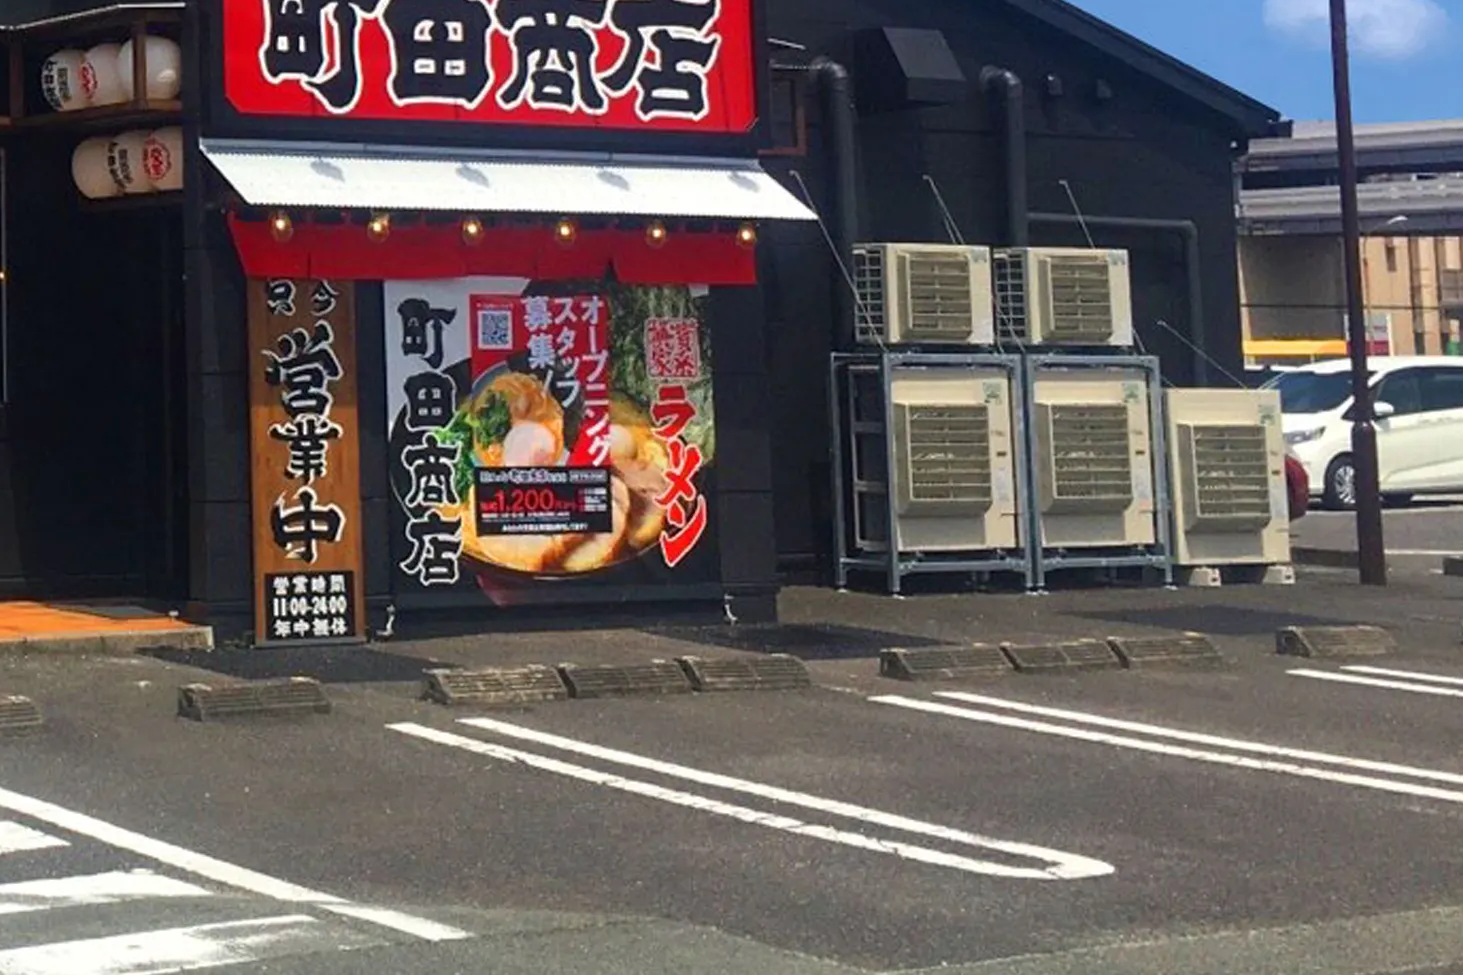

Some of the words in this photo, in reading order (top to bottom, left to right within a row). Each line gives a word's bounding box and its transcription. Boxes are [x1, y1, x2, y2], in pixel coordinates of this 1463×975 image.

[261, 320, 346, 565] 営業中
[396, 296, 462, 586] 町田商店
[553, 298, 581, 408] スタッフ
[579, 296, 612, 467] オープニング
[650, 385, 707, 567] ラーメン
